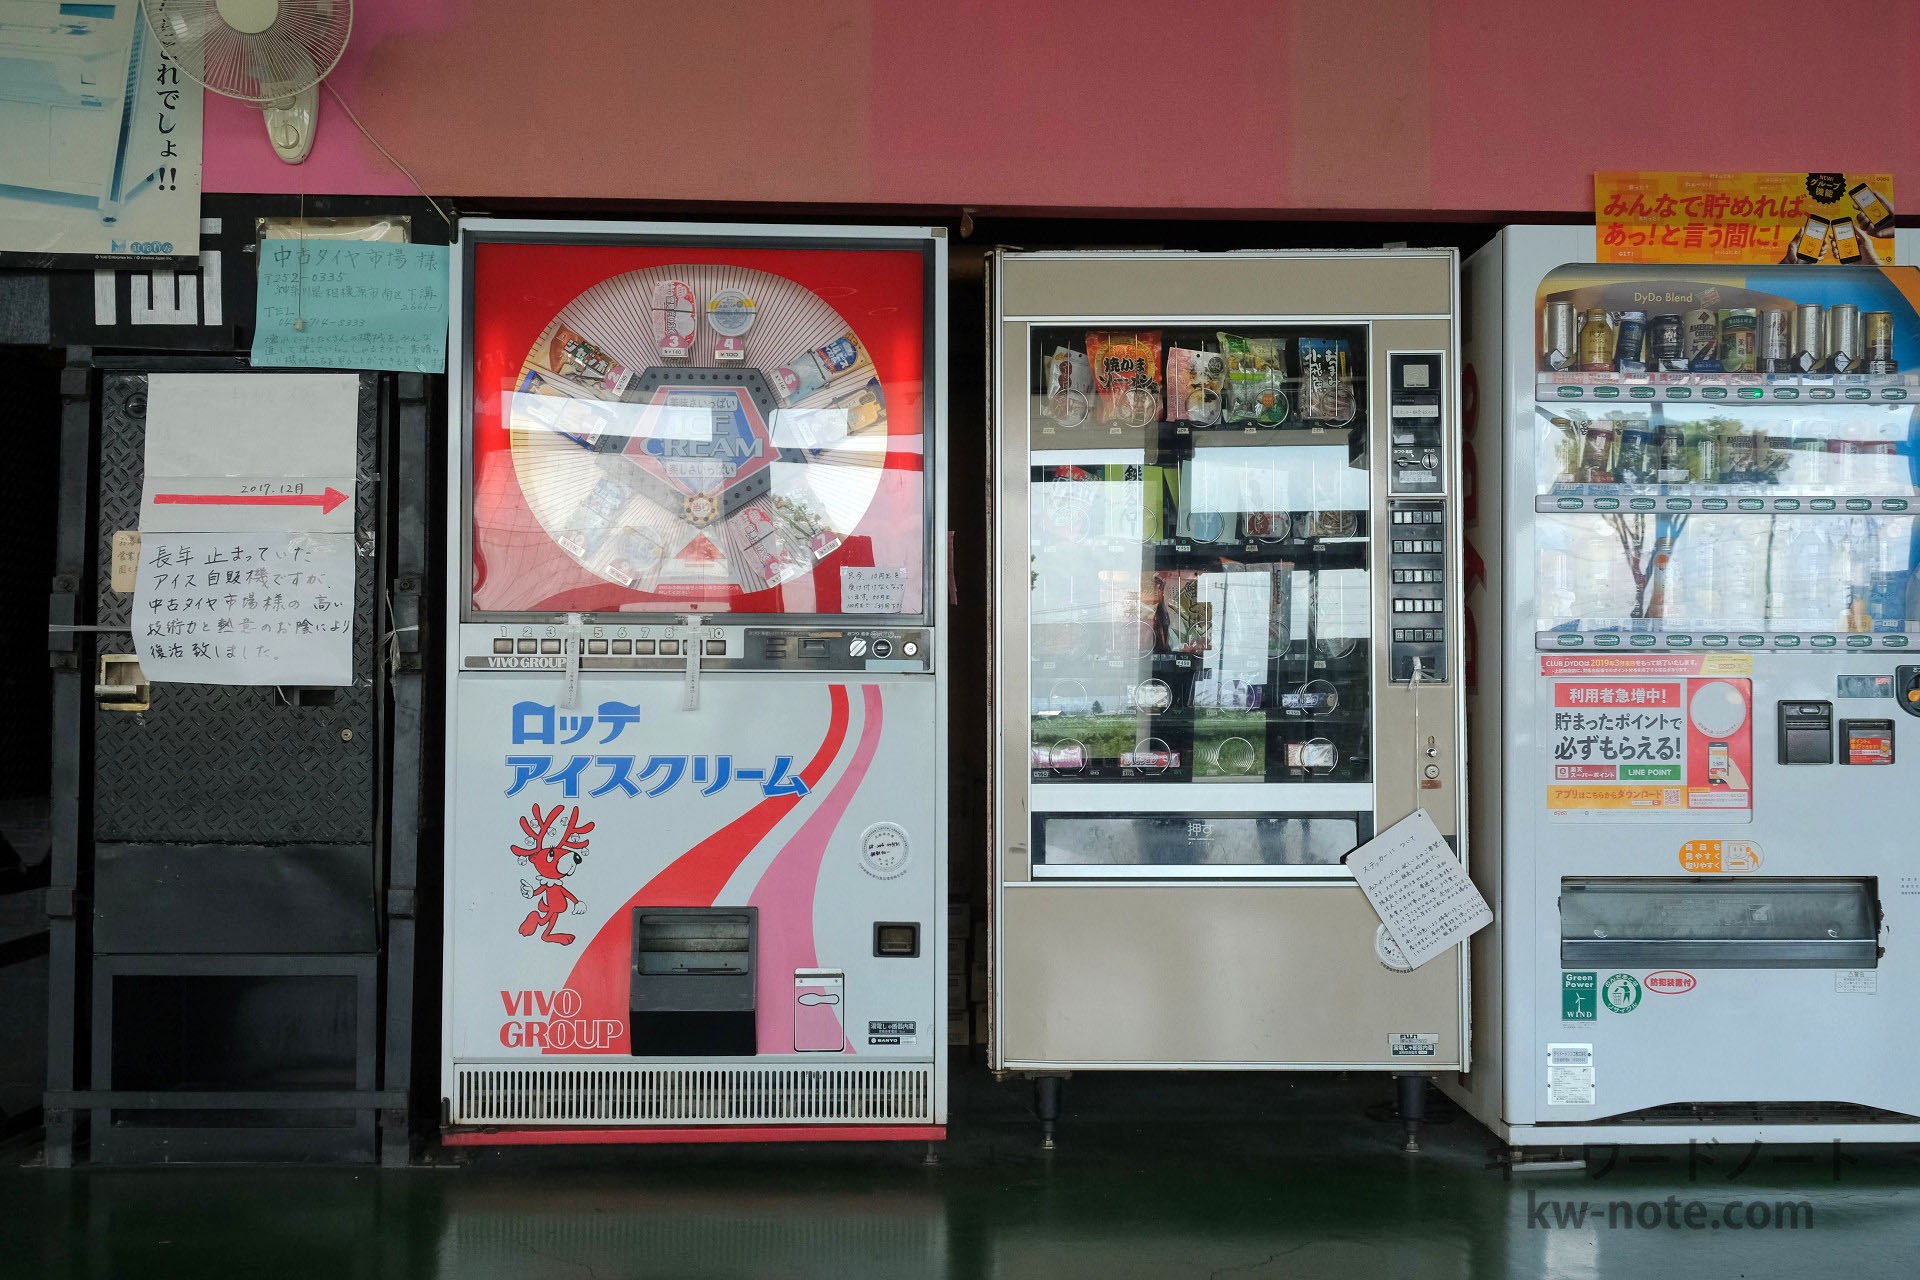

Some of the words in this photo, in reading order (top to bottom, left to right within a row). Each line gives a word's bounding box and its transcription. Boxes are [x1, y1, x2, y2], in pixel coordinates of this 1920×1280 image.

[1810, 178, 1842, 191] グループ
[1815, 187, 1834, 199] 機能
[1603, 193, 1810, 219] みんなで貯めれば、
[1603, 222, 1780, 249] あっ!と言う間に!
[1634, 292, 1662, 305] DyDo
[1665, 292, 1693, 303] Blend
[263, 306, 295, 318] TEL
[669, 336, 679, 347] 3
[724, 338, 734, 349] 4
[1103, 356, 1146, 373] 焼かま
[785, 373, 796, 384] 5
[639, 437, 764, 458] CREAM
[817, 533, 826, 546] 7
[148, 545, 312, 569] 長年止まっていた
[148, 593, 344, 614] 中古タイヤ市場様の高い
[499, 625, 507, 637] 1
[523, 625, 533, 637] 2
[546, 626, 556, 637] 3
[593, 627, 603, 638] 5
[617, 627, 627, 638] 6
[641, 627, 651, 638] 7
[664, 627, 674, 638] 8
[709, 627, 724, 639] 10
[488, 657, 519, 668] VIVO
[520, 657, 567, 668] GROUP
[1545, 660, 1563, 668] CLUB
[1569, 687, 1666, 704] 利用者急増中!
[511, 700, 641, 745] ロッテ
[1554, 712, 1683, 732] 貯まったポイントで
[1554, 735, 1682, 761] 必ずもらえる!
[503, 754, 812, 799] アイスクリーム
[1554, 789, 1662, 800] アプリはこちらからダウンロード
[1187, 822, 1215, 837] 押す
[1685, 843, 1721, 851] 商品を
[1565, 981, 1593, 989] Power
[1650, 978, 1692, 987] 防犯装置付
[500, 988, 582, 1018] VIVO
[499, 1019, 624, 1050] GROUP
